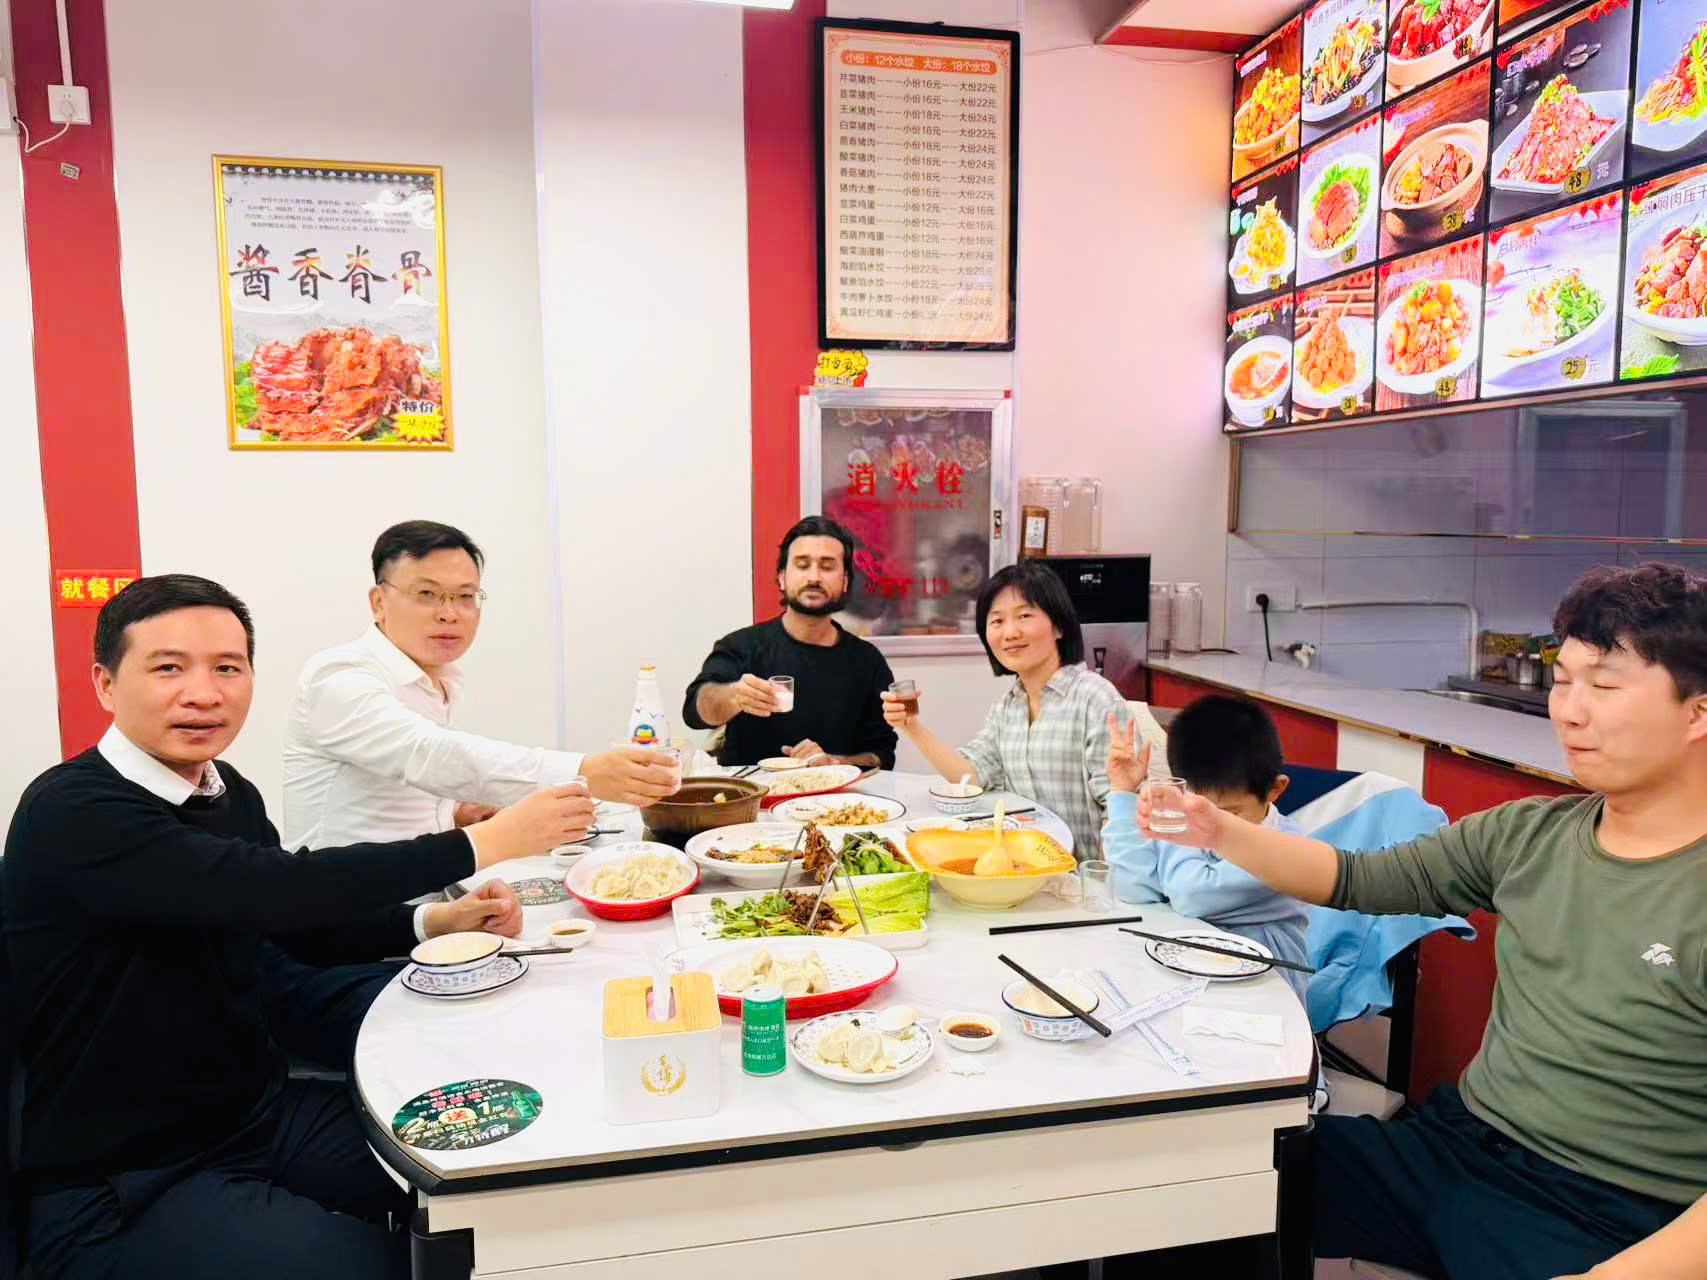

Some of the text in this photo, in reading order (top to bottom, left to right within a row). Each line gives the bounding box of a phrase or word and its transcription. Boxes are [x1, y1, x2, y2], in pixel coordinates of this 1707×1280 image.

[959, 82, 997, 93] 大份22元
[959, 98, 997, 109] 大份22元
[959, 114, 996, 124] 大份24元
[840, 120, 876, 132] 白菜猪肉
[959, 129, 996, 140] 大份22元
[959, 144, 996, 155] 大份24元
[840, 152, 876, 164] 酸菜猪肉
[959, 159, 996, 170] 大份24元
[1597, 161, 1610, 179] 元
[840, 168, 995, 185] 香菇猪肉 小份18元 大份24元
[840, 184, 876, 193] 猪肉大葱
[958, 190, 995, 200] 大份22元
[903, 203, 941, 213] 小份12元
[903, 218, 941, 228] 小份12元
[903, 234, 941, 243] 小份12元
[903, 264, 940, 274] 小份22元
[903, 280, 940, 289] 小份22元
[1565, 360, 1580, 376] 25
[402, 400, 435, 413] 特价
[847, 464, 965, 496] 消火栓
[447, 1110, 468, 1122] 送
